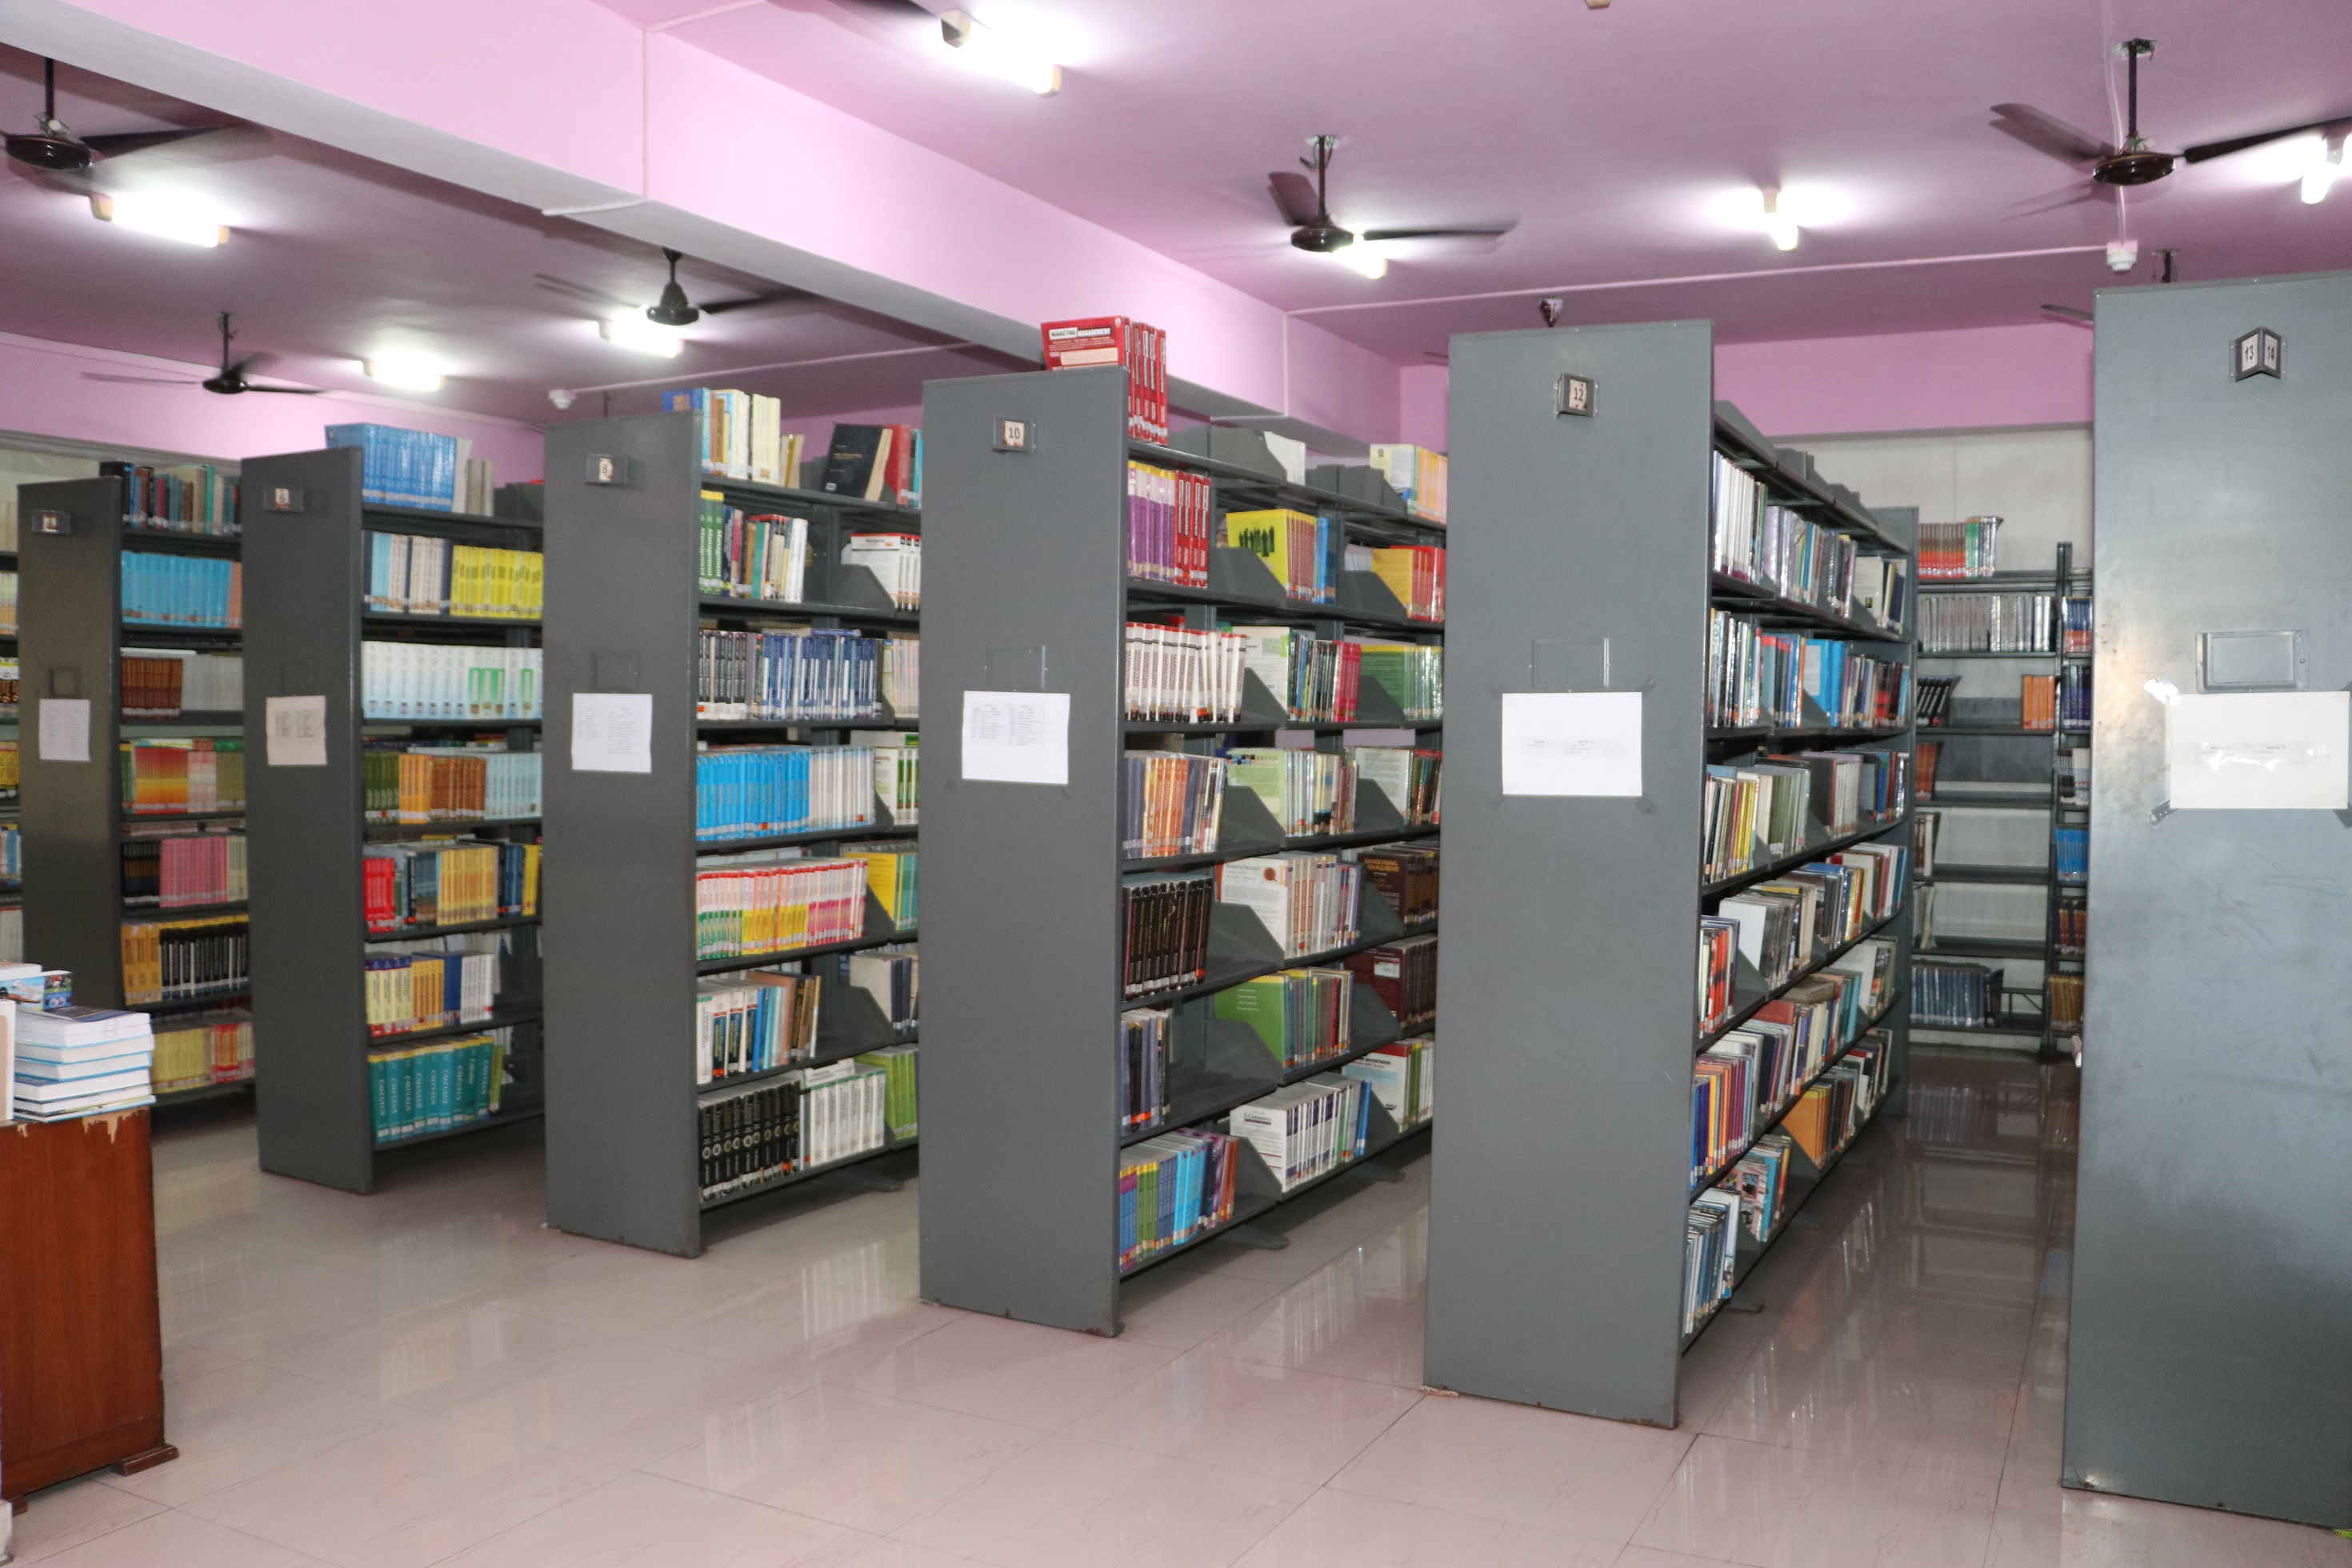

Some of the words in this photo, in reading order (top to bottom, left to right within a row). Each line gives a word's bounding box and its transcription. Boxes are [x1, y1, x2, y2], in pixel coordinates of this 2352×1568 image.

[1051, 329, 1076, 338] MARKETING
[1078, 327, 1110, 337] MANAGEMENT
[2245, 345, 2254, 361] 13
[1574, 387, 1584, 401] 12
[1008, 427, 1020, 438] 10
[602, 464, 608, 474] 8
[279, 494, 286, 502] 6
[1365, 858, 1398, 866] ADVERTISING
